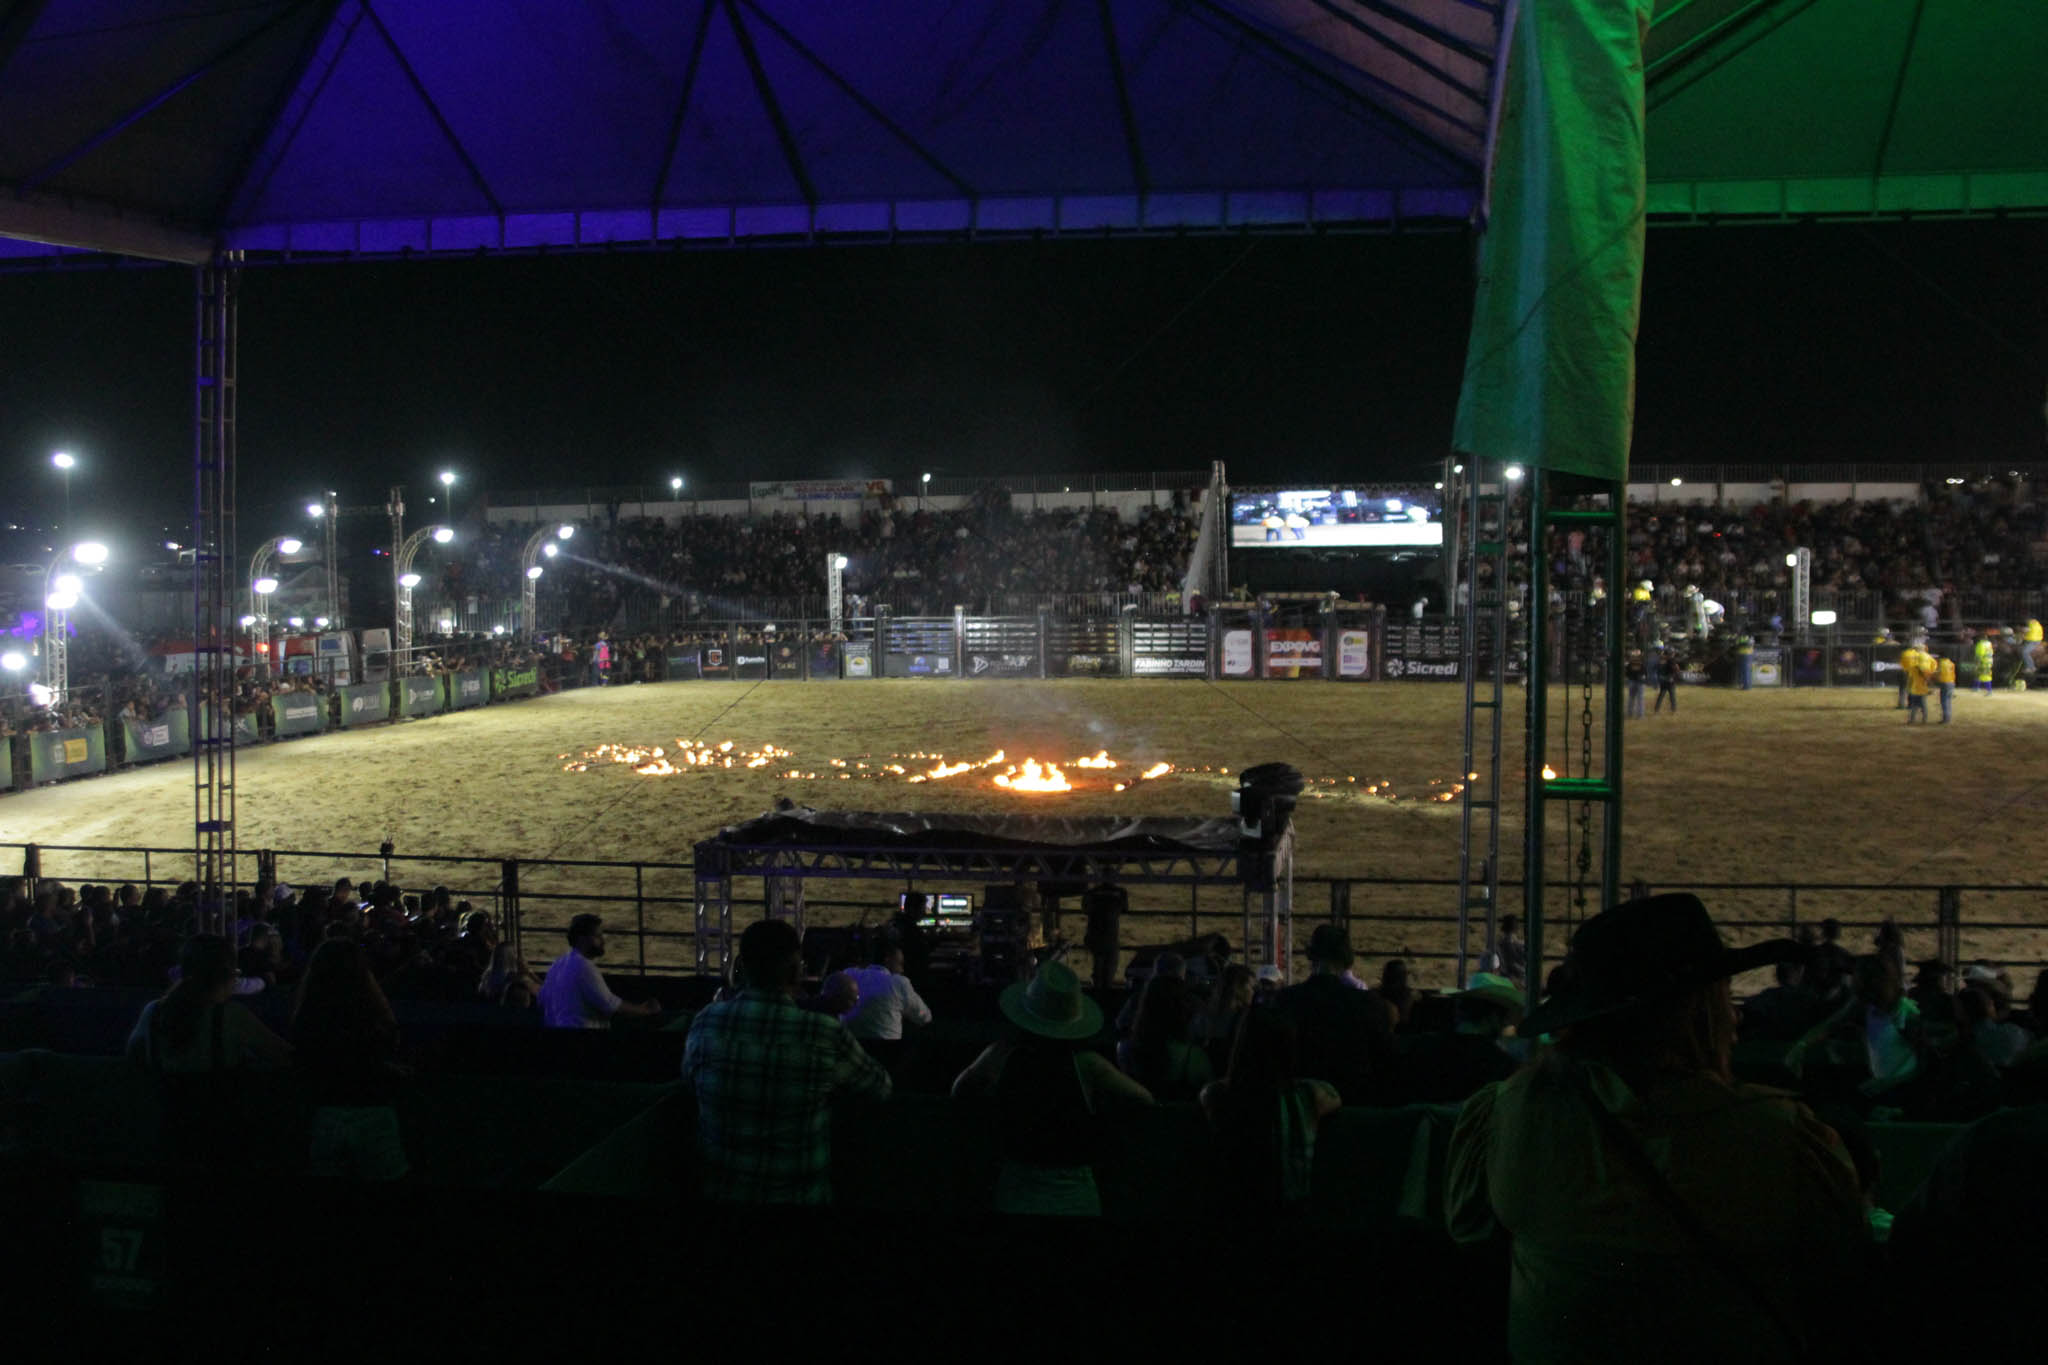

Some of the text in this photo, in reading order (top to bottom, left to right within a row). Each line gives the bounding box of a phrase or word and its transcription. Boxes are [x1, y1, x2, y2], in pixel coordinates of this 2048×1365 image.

[1270, 640, 1321, 653] EXPOVG
[1134, 657, 1206, 668] FABINHO TARDIN
[1406, 661, 1459, 675] Sicredi
